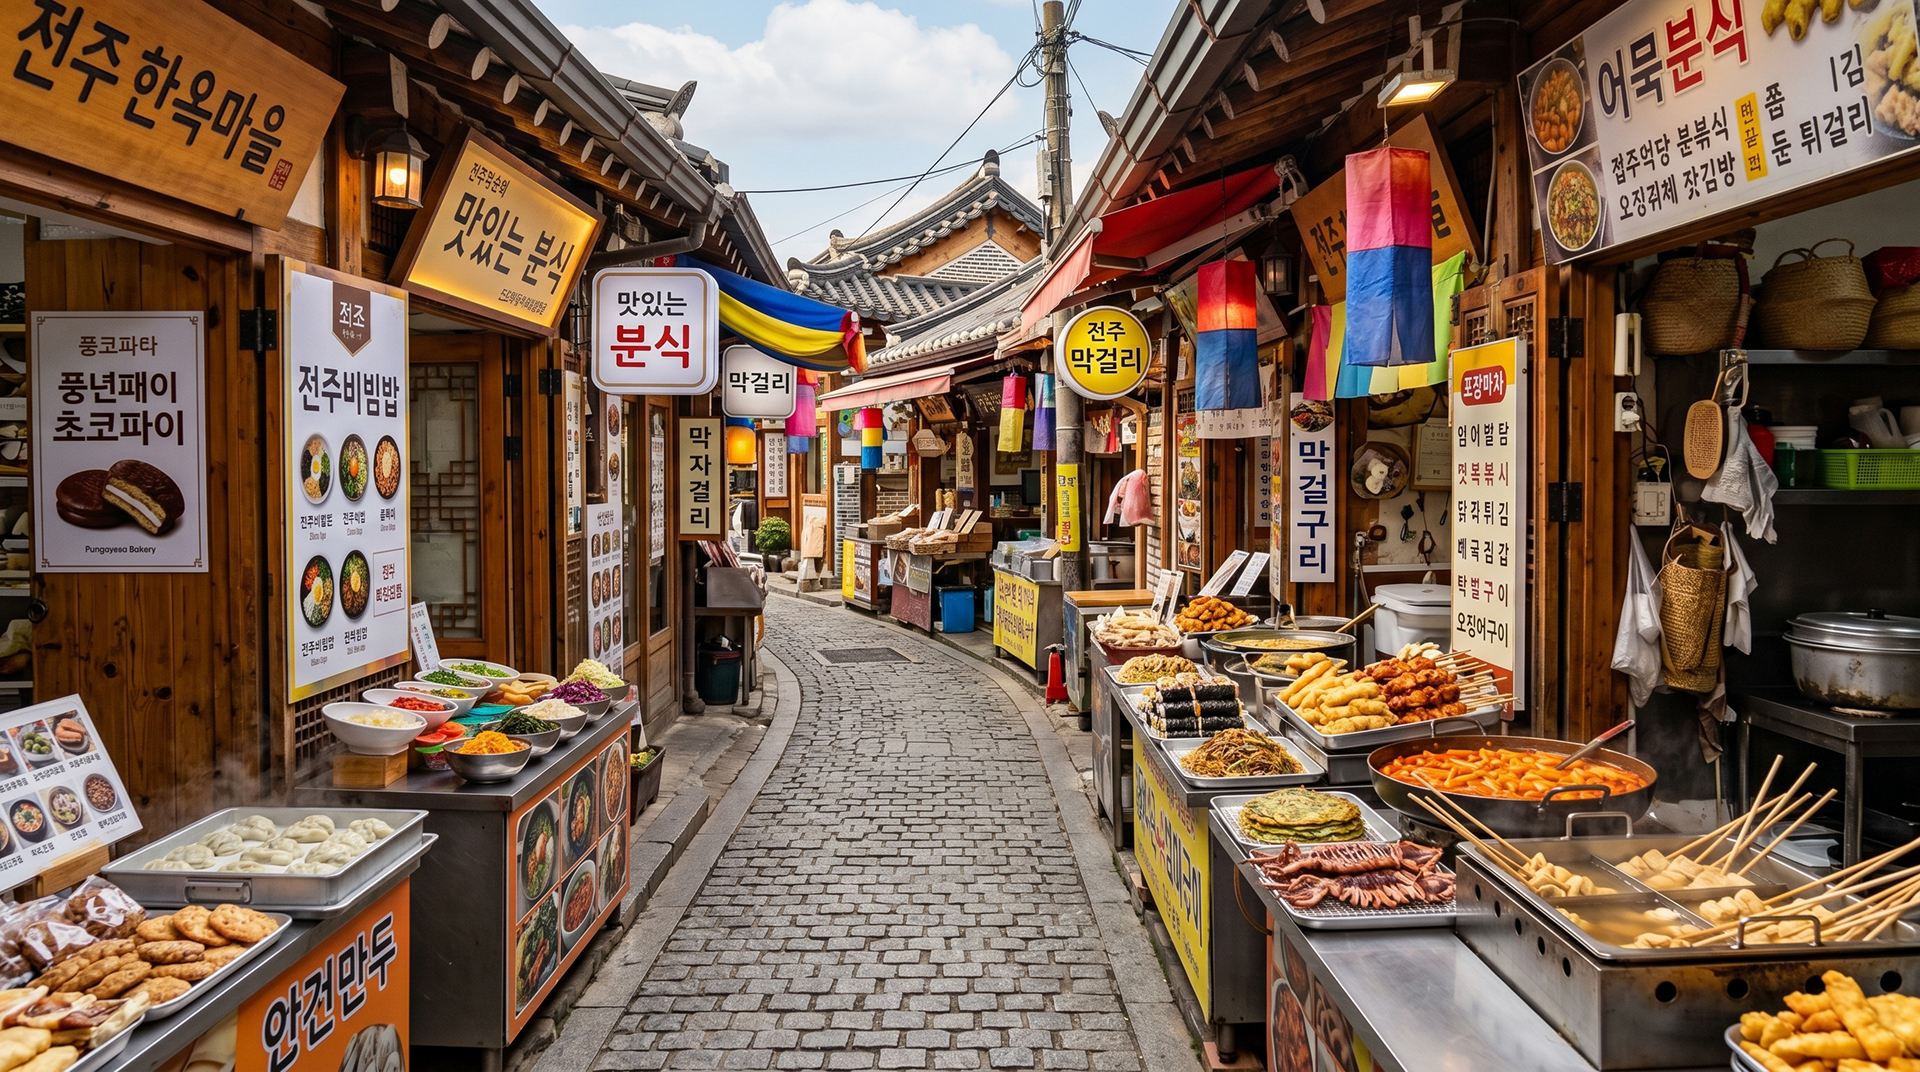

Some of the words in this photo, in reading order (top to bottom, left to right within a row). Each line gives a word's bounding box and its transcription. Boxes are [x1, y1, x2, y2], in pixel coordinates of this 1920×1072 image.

[1599, 0, 1748, 120] 어묵분식
[13, 0, 130, 103] 전주
[124, 46, 286, 175] 한옥마을
[1799, 95, 1872, 155] 튀걸리
[444, 192, 525, 276] 맛있는
[522, 231, 575, 295] 분식
[617, 290, 688, 317] 맛있는
[78, 335, 158, 357] 풍코파타
[610, 325, 690, 369] 분식
[1087, 321, 1126, 342] 전주
[1071, 347, 1141, 374] 막걸리
[57, 371, 178, 405] 풍년패이
[298, 365, 400, 418] 전주비빔밥
[729, 372, 790, 395] 막걸리
[1463, 370, 1504, 400] 포장마차
[52, 409, 185, 446] 초코파이
[1296, 440, 1331, 574] 막걸구리
[129, 545, 157, 555] Bakery
[1456, 612, 1508, 648] 오징어구이
[263, 912, 397, 1072] 안건만두
